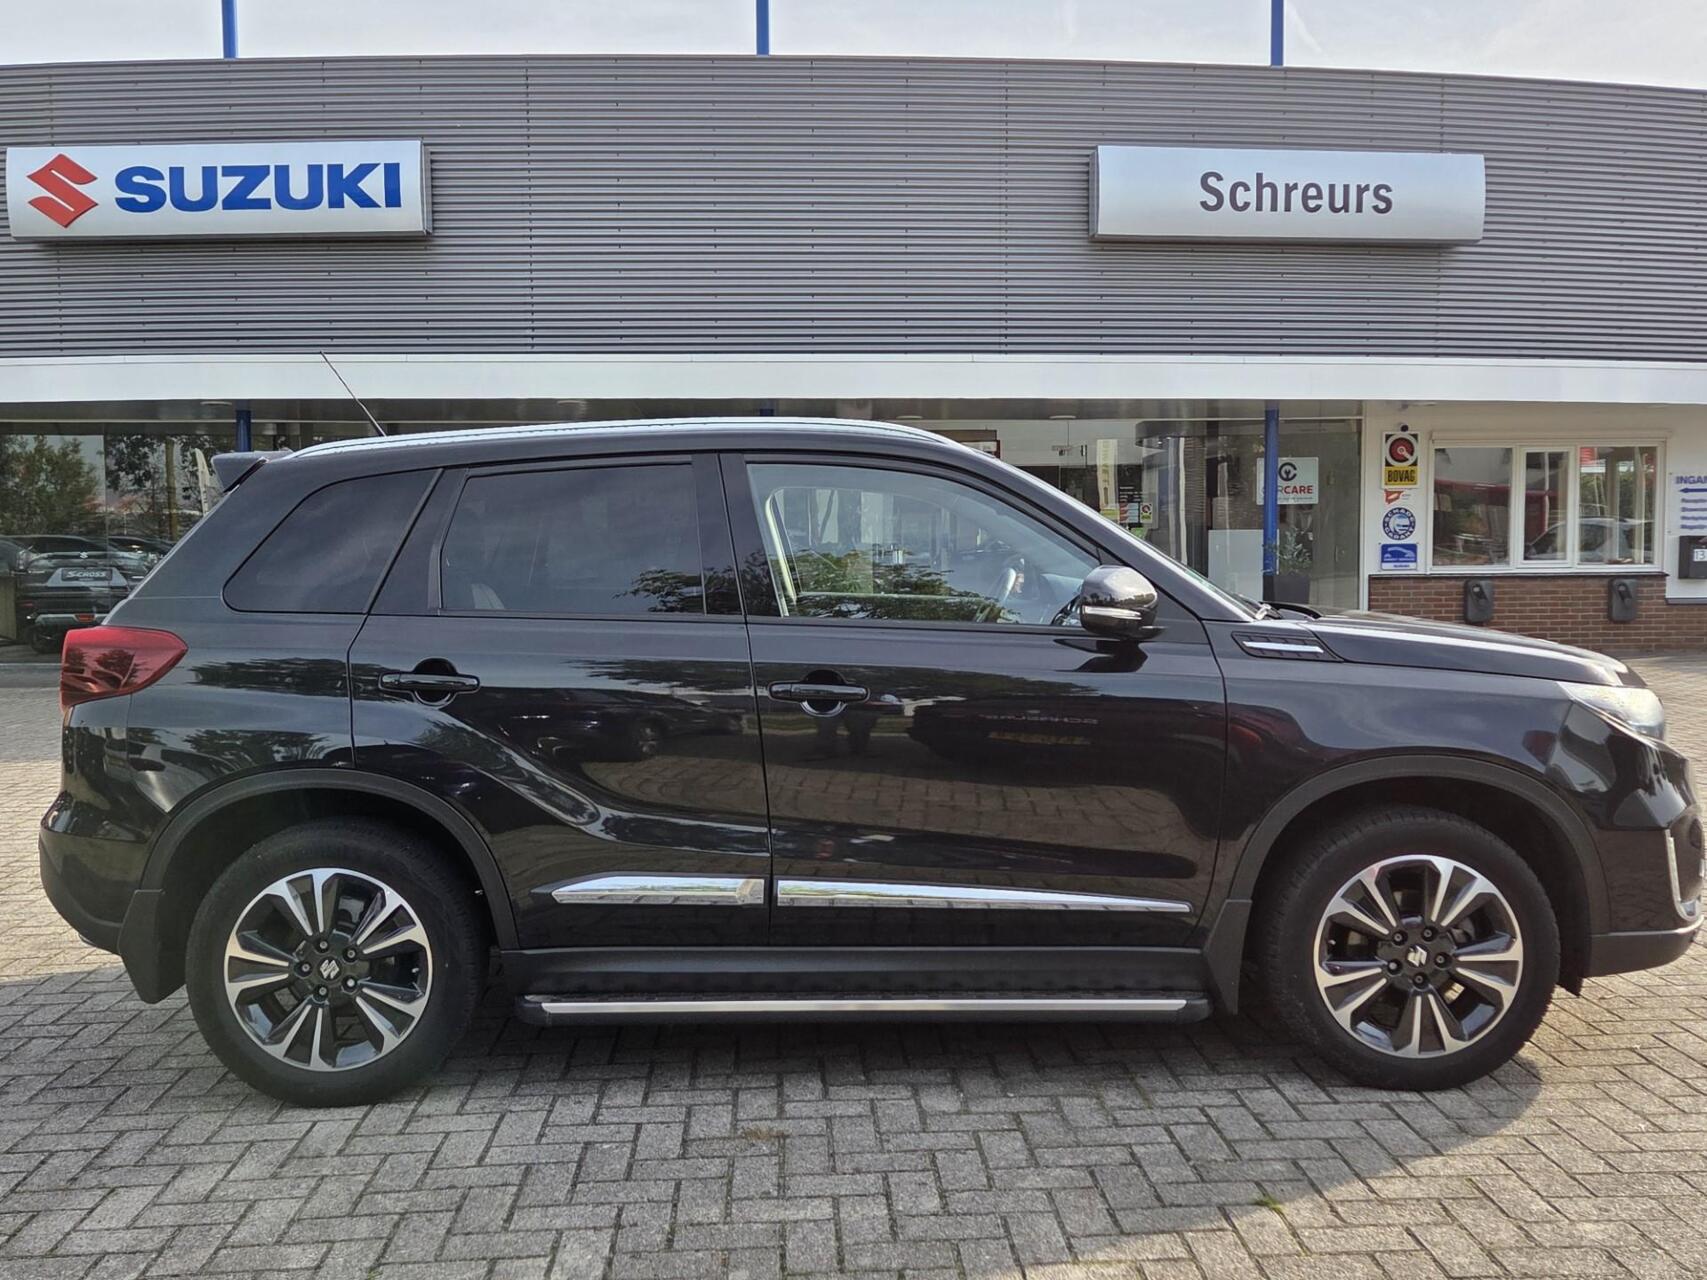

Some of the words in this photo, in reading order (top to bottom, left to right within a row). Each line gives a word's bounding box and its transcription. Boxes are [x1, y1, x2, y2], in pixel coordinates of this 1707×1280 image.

[115, 162, 402, 213] SUZUKI
[1199, 171, 1393, 214] Schreurs
[1388, 470, 1415, 482] BOVAG
